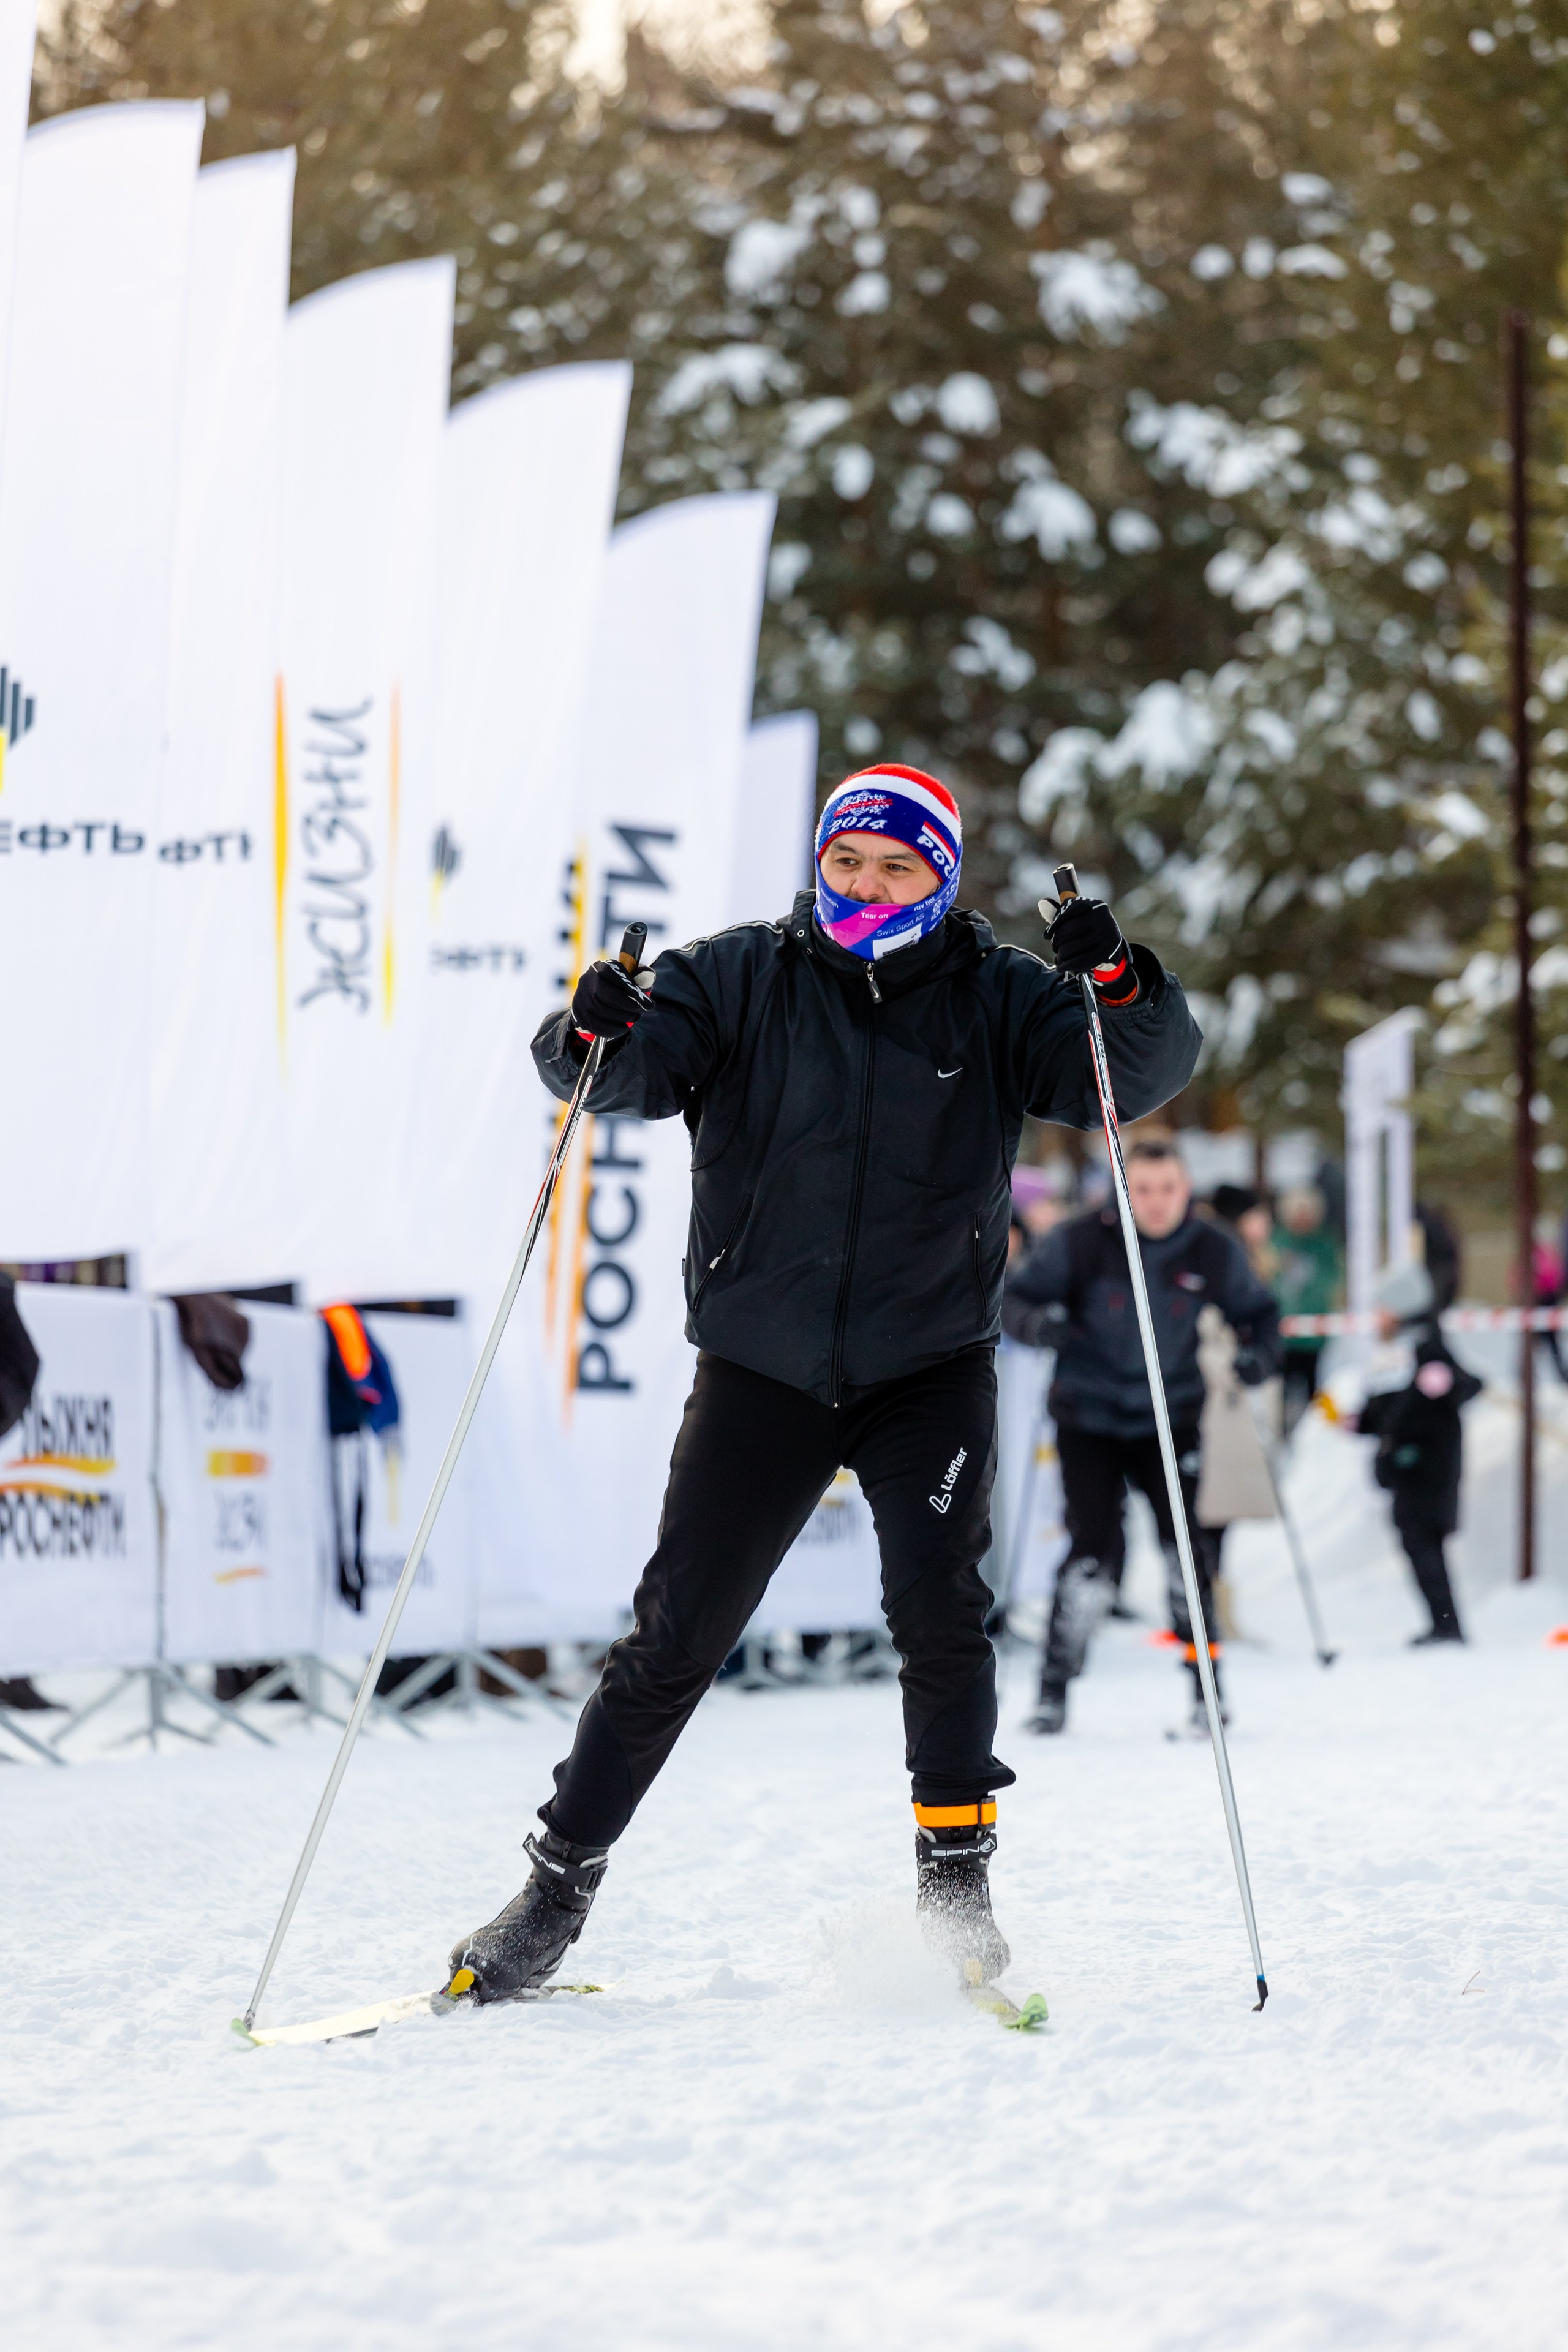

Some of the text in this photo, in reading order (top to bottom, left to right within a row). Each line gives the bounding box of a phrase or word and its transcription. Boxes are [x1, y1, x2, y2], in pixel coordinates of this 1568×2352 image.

[829, 816, 888, 835] 2014
[896, 919, 914, 932] Sport
[915, 913, 925, 923] AS
[940, 1447, 968, 1491] Löffler
